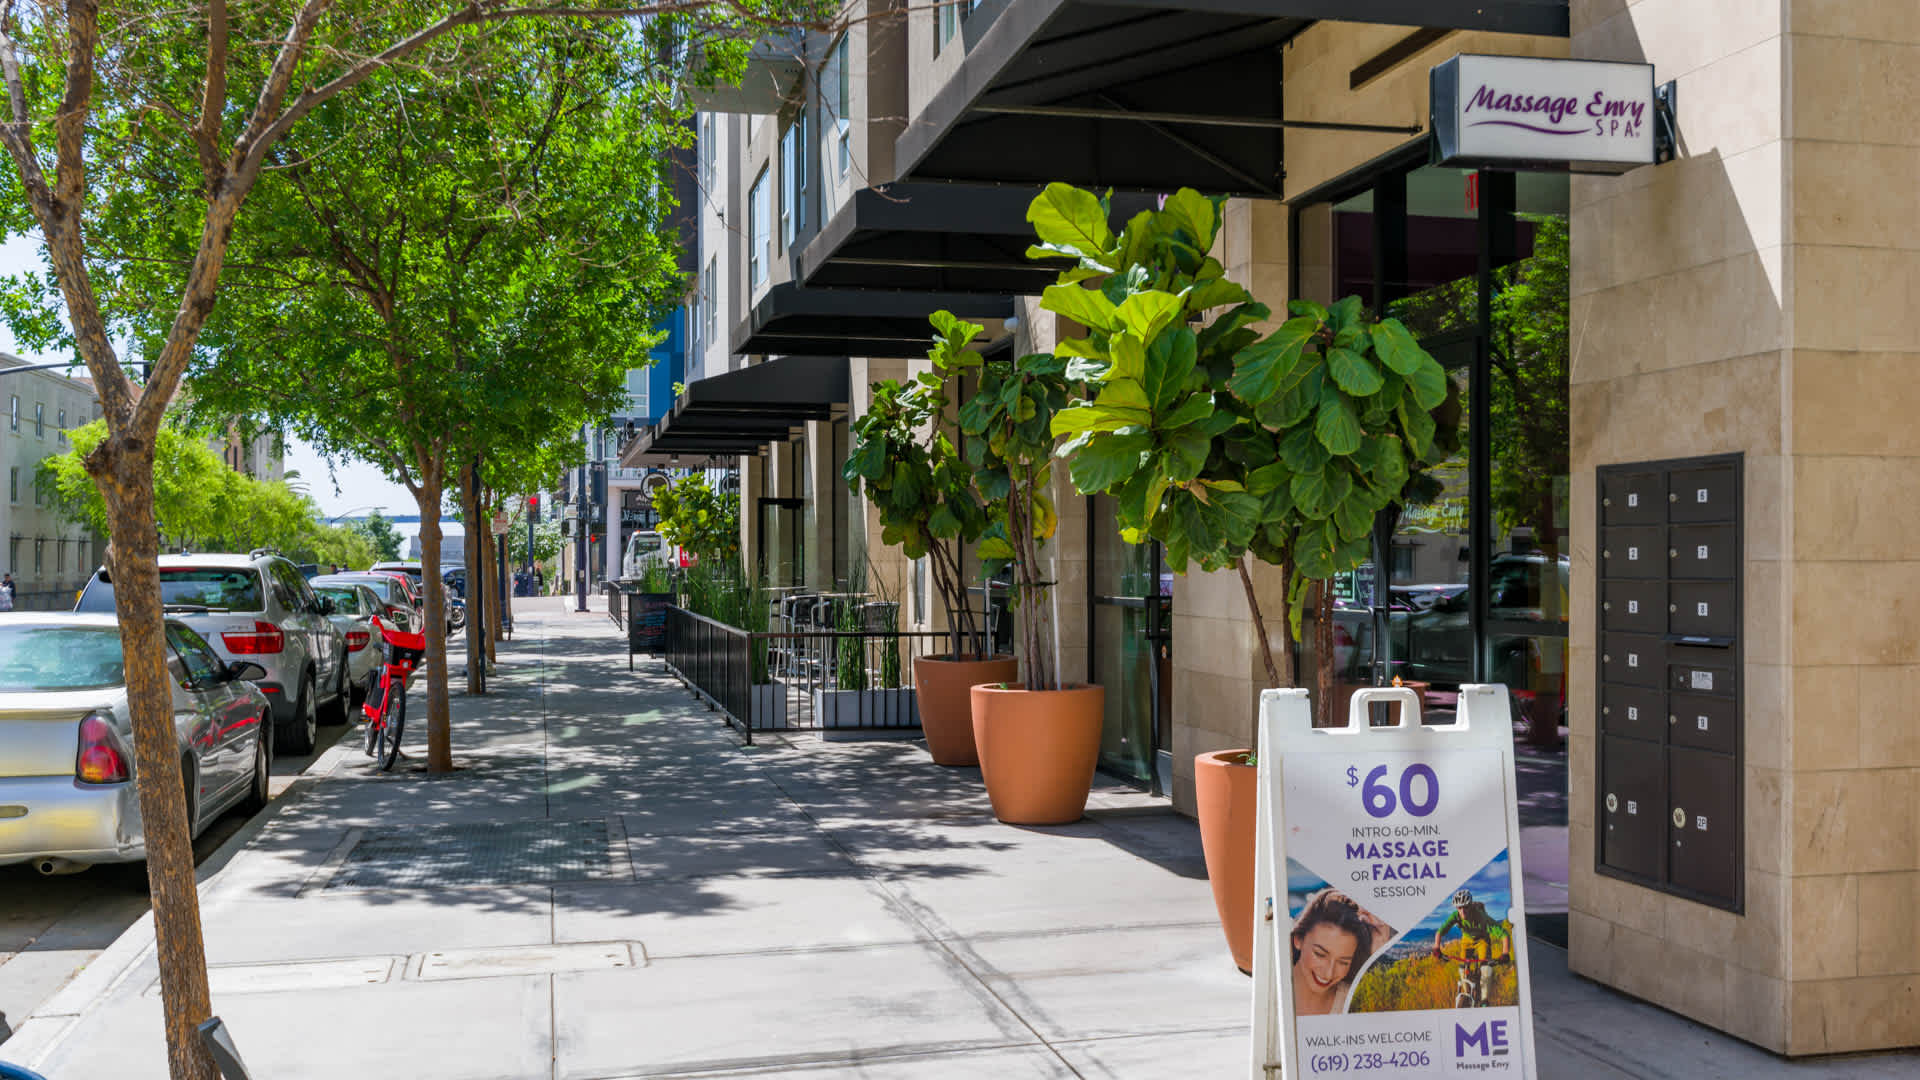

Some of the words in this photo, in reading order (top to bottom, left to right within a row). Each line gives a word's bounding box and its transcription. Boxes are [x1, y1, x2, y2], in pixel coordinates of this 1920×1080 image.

[1464, 84, 1578, 124] Massage
[1585, 91, 1646, 128] Envy
[1346, 763, 1440, 819] $60
[1352, 826, 1391, 838] INTRO
[1394, 824, 1441, 837] 60-MIN.
[1345, 840, 1449, 860] MASSAGE
[1350, 871, 1369, 882] OR
[1372, 862, 1447, 881] FACIAL
[1373, 885, 1426, 898] SESSION
[1305, 1034, 1366, 1049] WALK-INS
[1367, 1030, 1432, 1046] WELCOME
[1455, 1019, 1509, 1057] ME
[1311, 1053, 1350, 1074] (619)
[1353, 1050, 1431, 1070] 238-4206
[1456, 1061, 1490, 1073] Massage
[1491, 1060, 1510, 1071] Envy
